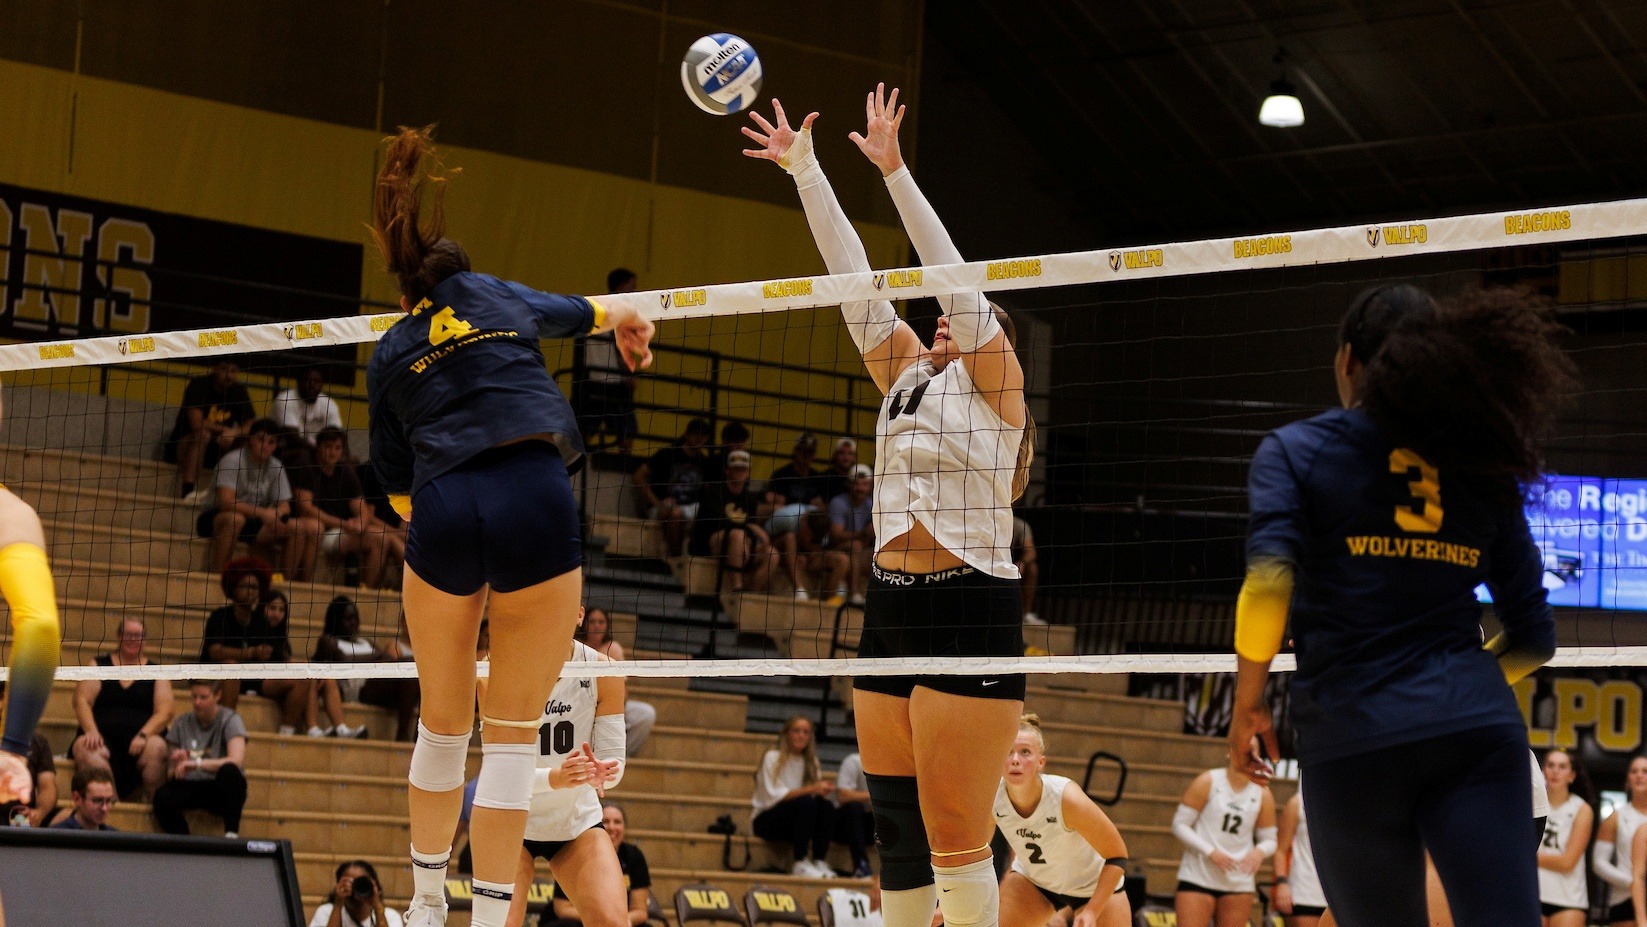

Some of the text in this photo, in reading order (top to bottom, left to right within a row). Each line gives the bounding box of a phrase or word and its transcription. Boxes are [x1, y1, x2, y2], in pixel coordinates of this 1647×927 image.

[704, 44, 741, 75] molten
[39, 344, 75, 360] BEACONS
[198, 330, 238, 347] BEACONS
[295, 323, 323, 339] VALPO
[673, 289, 706, 307] VALPO
[762, 279, 813, 299] BEACONS
[887, 270, 923, 288] VALPO
[987, 259, 1042, 280] BEACONS
[1124, 249, 1163, 269] VALPO
[1234, 235, 1292, 259] BEACONS
[1383, 224, 1427, 245] VALPO
[1504, 210, 1571, 235] BEACONS
[428, 305, 480, 346] 4
[1388, 448, 1444, 534] 3
[1346, 536, 1480, 568] WOLVERINES
[882, 571, 915, 586] PRO
[545, 700, 572, 716] Valpo
[539, 720, 574, 755] 10
[1016, 828, 1041, 840] Valpo
[1222, 813, 1243, 834] 12
[1025, 842, 1047, 864] 2
[483, 889, 504, 898] GRIP
[684, 889, 730, 909] VALPO
[753, 891, 797, 912] VALPO
